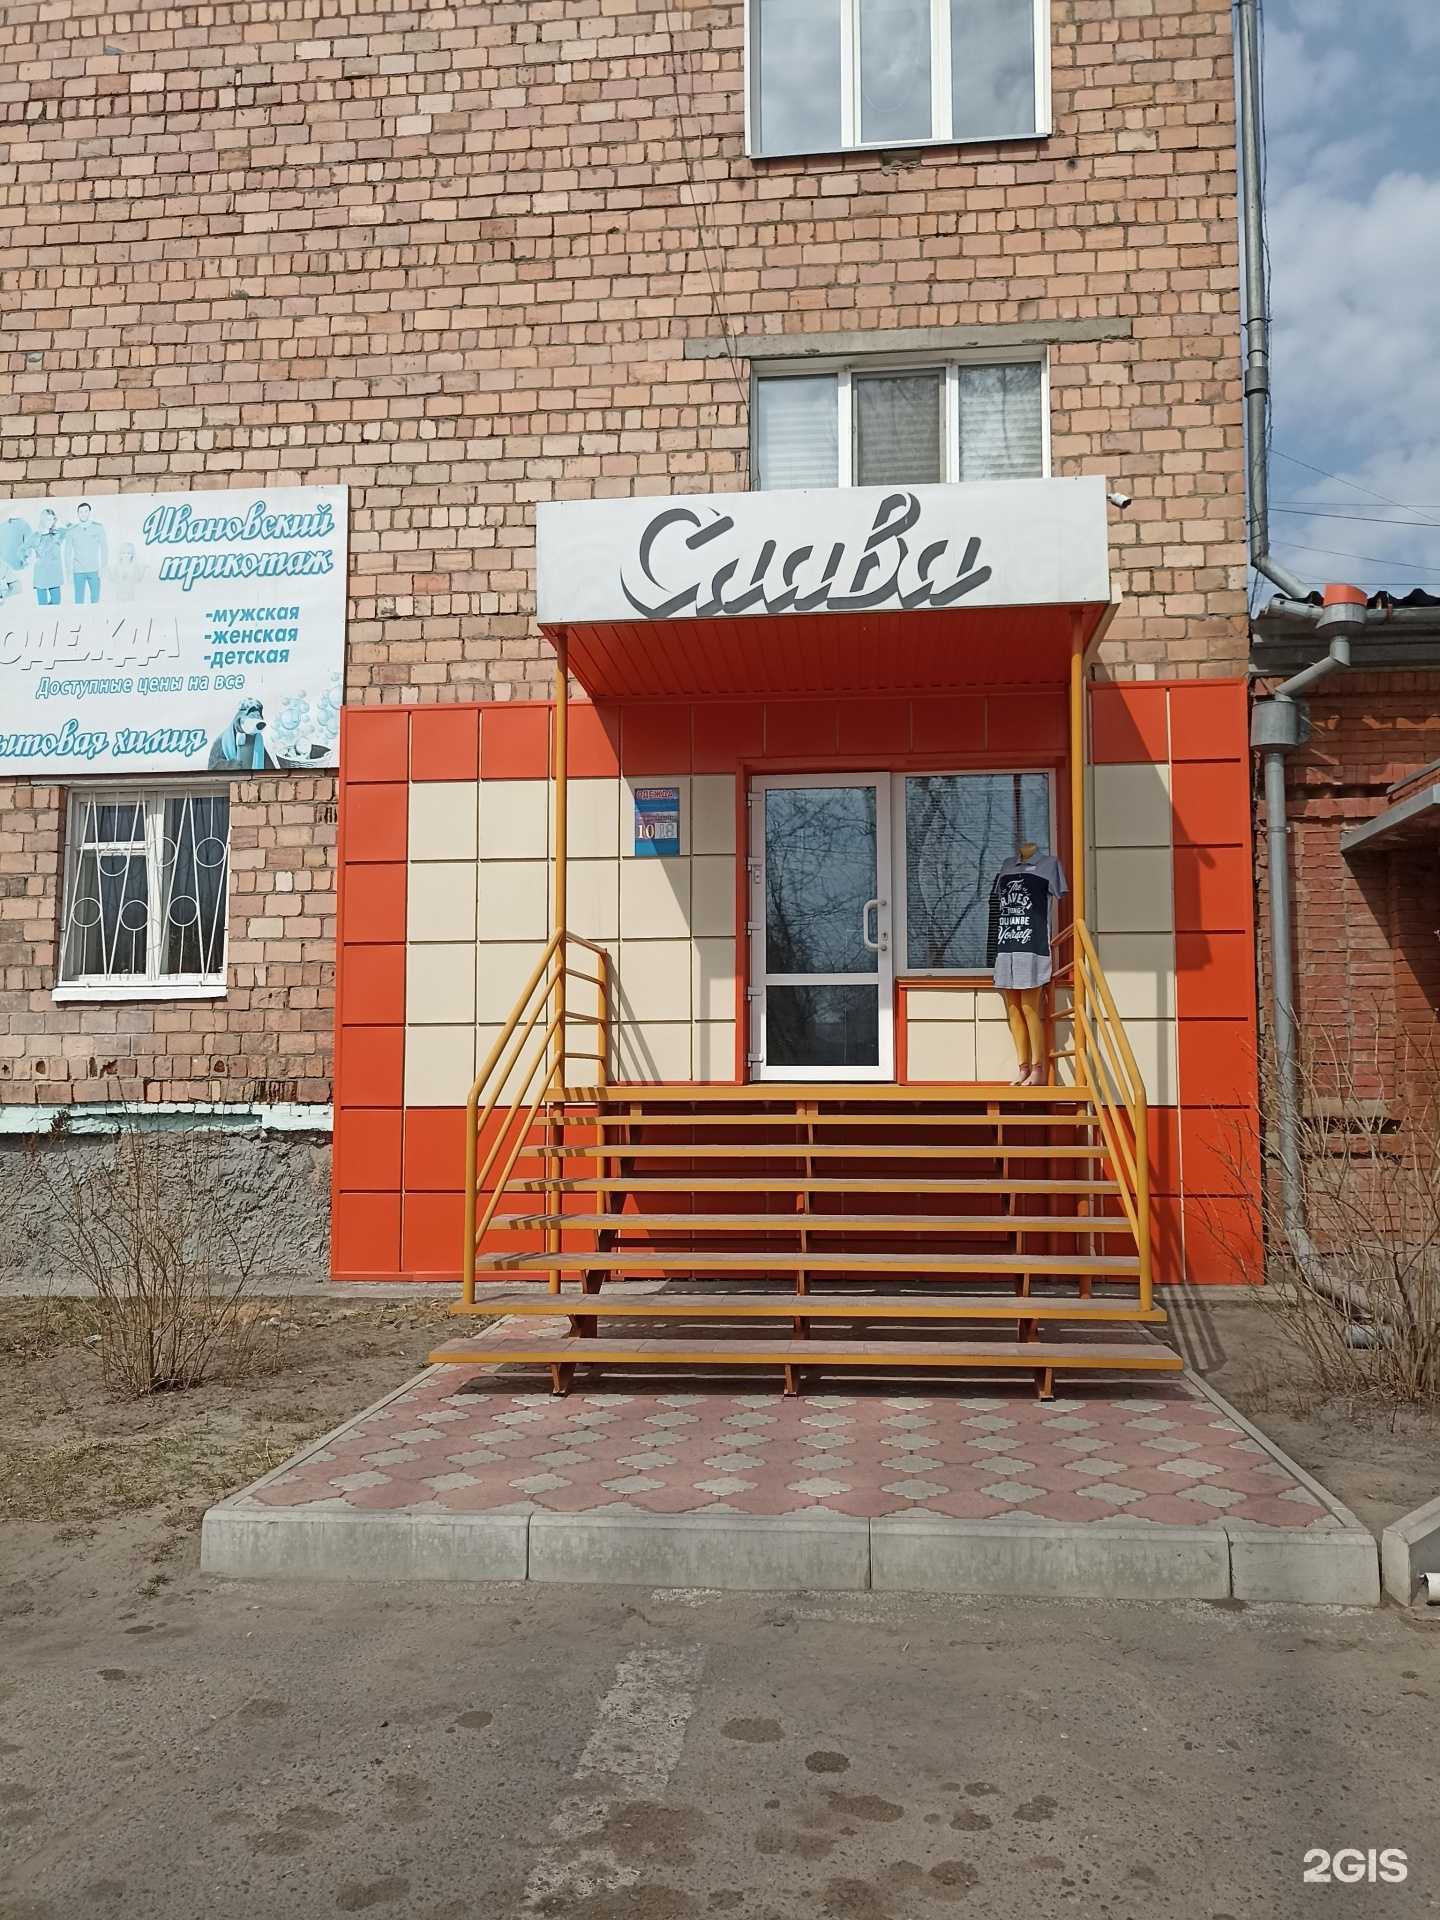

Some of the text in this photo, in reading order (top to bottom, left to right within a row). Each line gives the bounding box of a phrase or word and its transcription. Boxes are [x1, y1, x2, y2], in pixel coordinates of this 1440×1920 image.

[143, 500, 336, 545] Ивановский
[159, 549, 334, 591] трикотаж
[205, 606, 300, 627] -мужская
[204, 627, 299, 646] -женская
[203, 648, 290, 669] -детская
[36, 673, 245, 699] Доступные цены на все
[0, 719, 208, 759] ытовая химия
